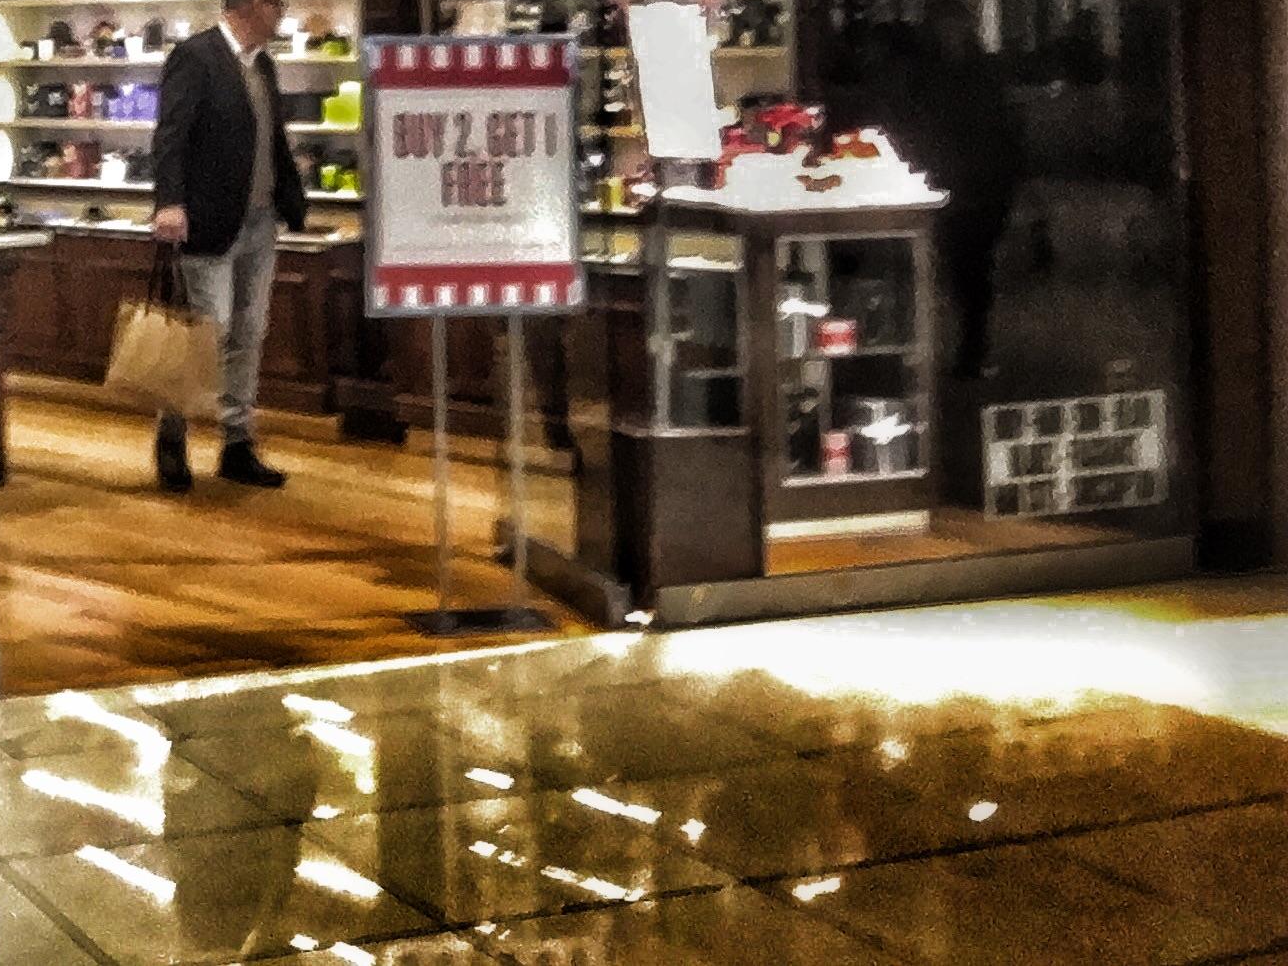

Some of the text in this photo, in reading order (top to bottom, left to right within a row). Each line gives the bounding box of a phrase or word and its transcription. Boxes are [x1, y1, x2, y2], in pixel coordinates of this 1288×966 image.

[392, 111, 447, 159] BUY
[486, 109, 537, 159] GET
[440, 160, 508, 208] FREE
